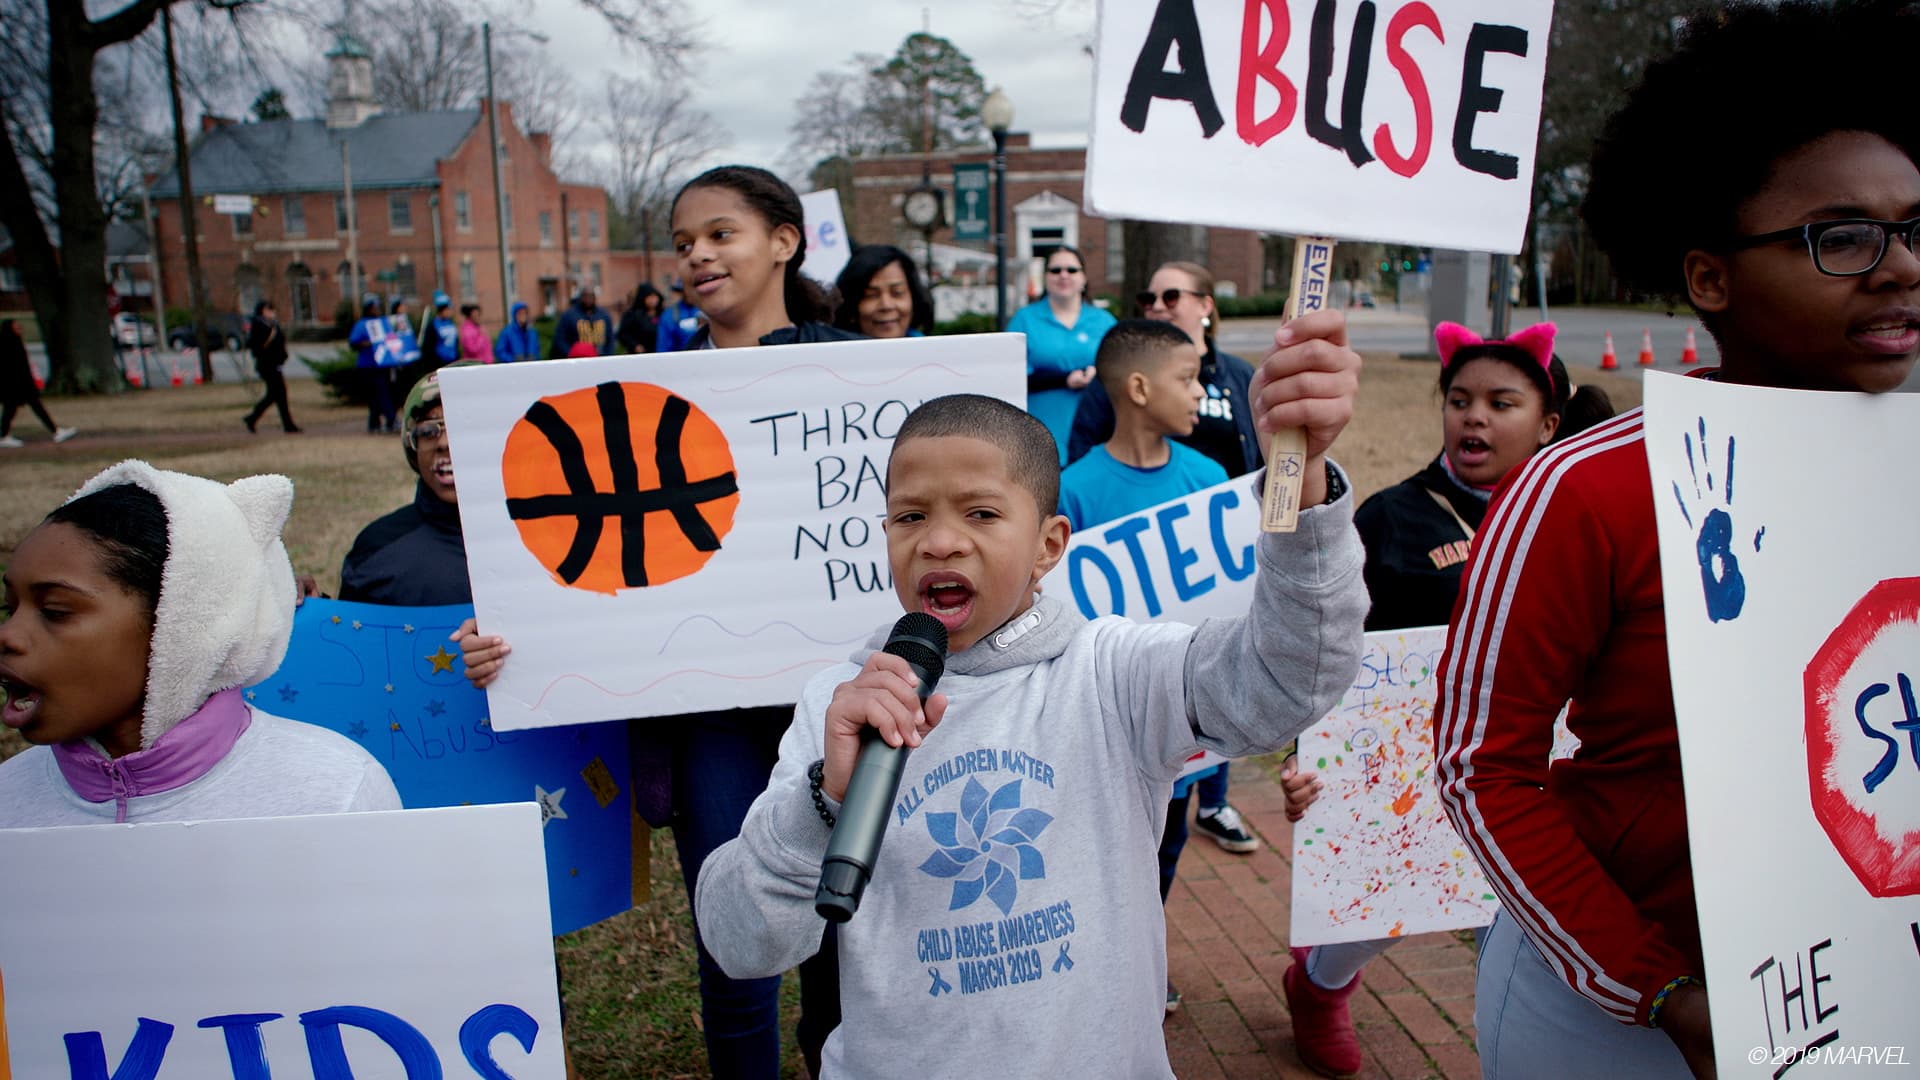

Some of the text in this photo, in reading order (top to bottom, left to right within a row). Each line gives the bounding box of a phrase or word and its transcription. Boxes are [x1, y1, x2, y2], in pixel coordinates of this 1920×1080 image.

[1120, 0, 1529, 180] ABUSE
[1306, 245, 1328, 310] EVER
[750, 400, 923, 456] THRO
[794, 514, 887, 560] NO
[1428, 540, 1471, 570] HAR
[824, 559, 892, 601] PU
[896, 786, 924, 826] ALL
[924, 749, 998, 796] CHILDREN
[917, 900, 1075, 963] CHILD ABUSE AWARENESS
[958, 948, 1043, 995] MARCH 2019
[1750, 938, 1838, 1057] THE
